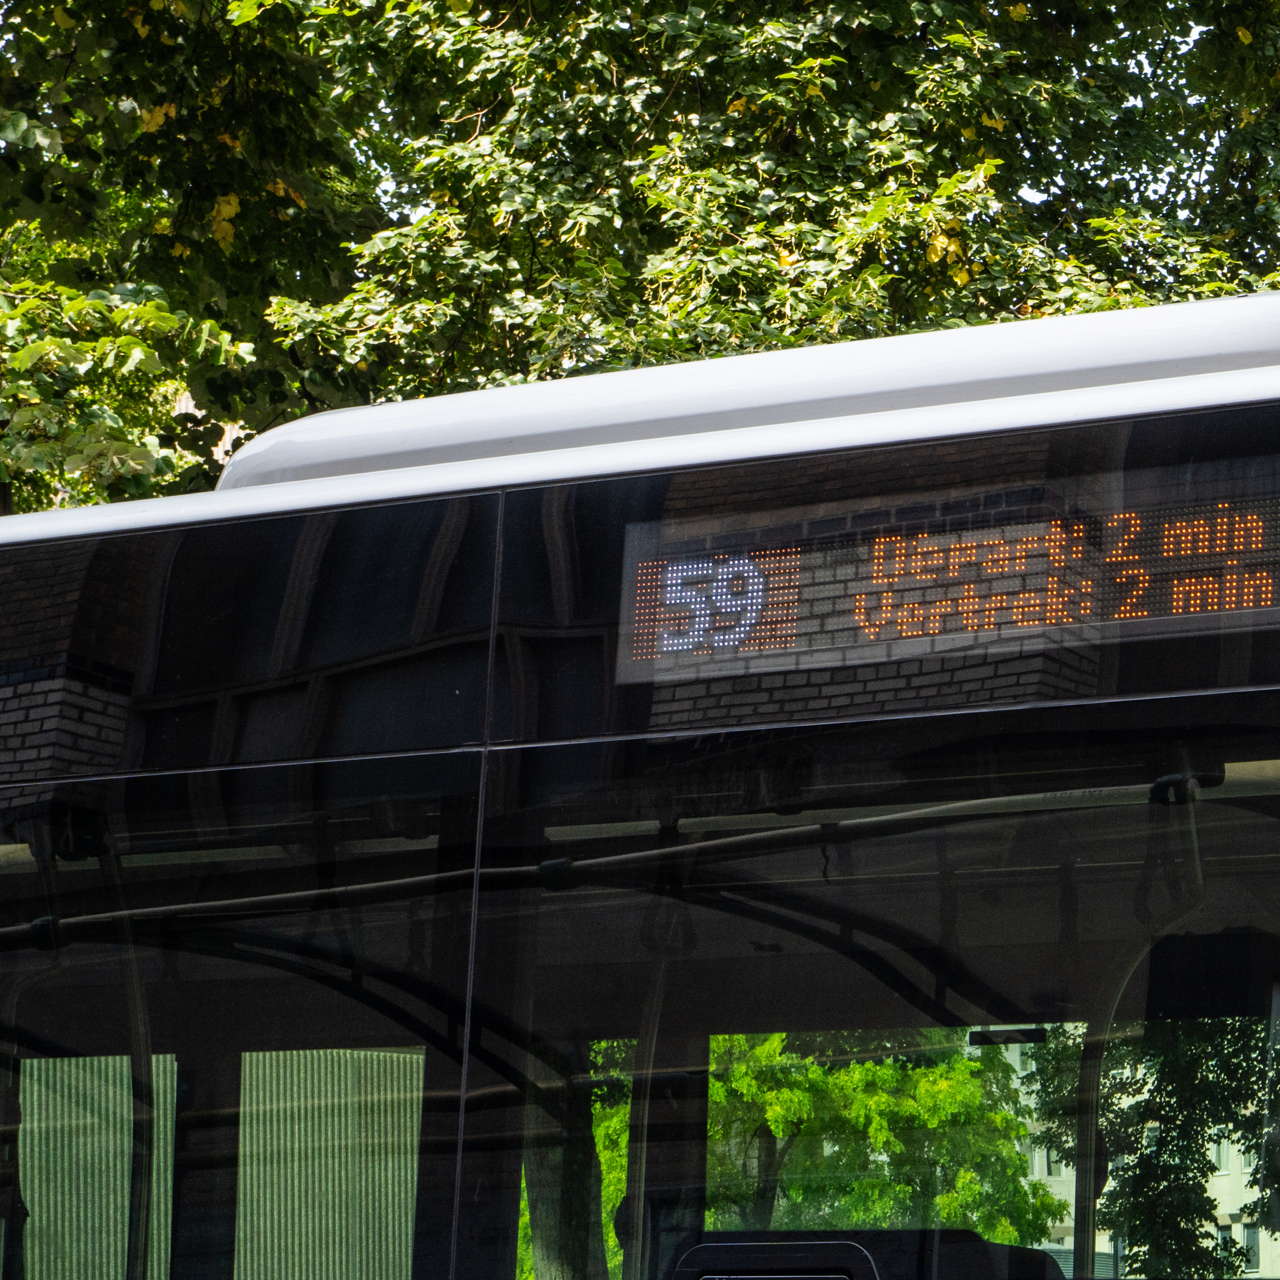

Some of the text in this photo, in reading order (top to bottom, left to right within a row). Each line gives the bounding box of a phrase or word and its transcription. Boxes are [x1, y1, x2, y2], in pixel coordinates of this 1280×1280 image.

[1105, 511, 1142, 562] 2
[1161, 502, 1264, 557] min
[662, 558, 765, 652] 59
[853, 558, 1274, 641] Vertrek: 2 min
